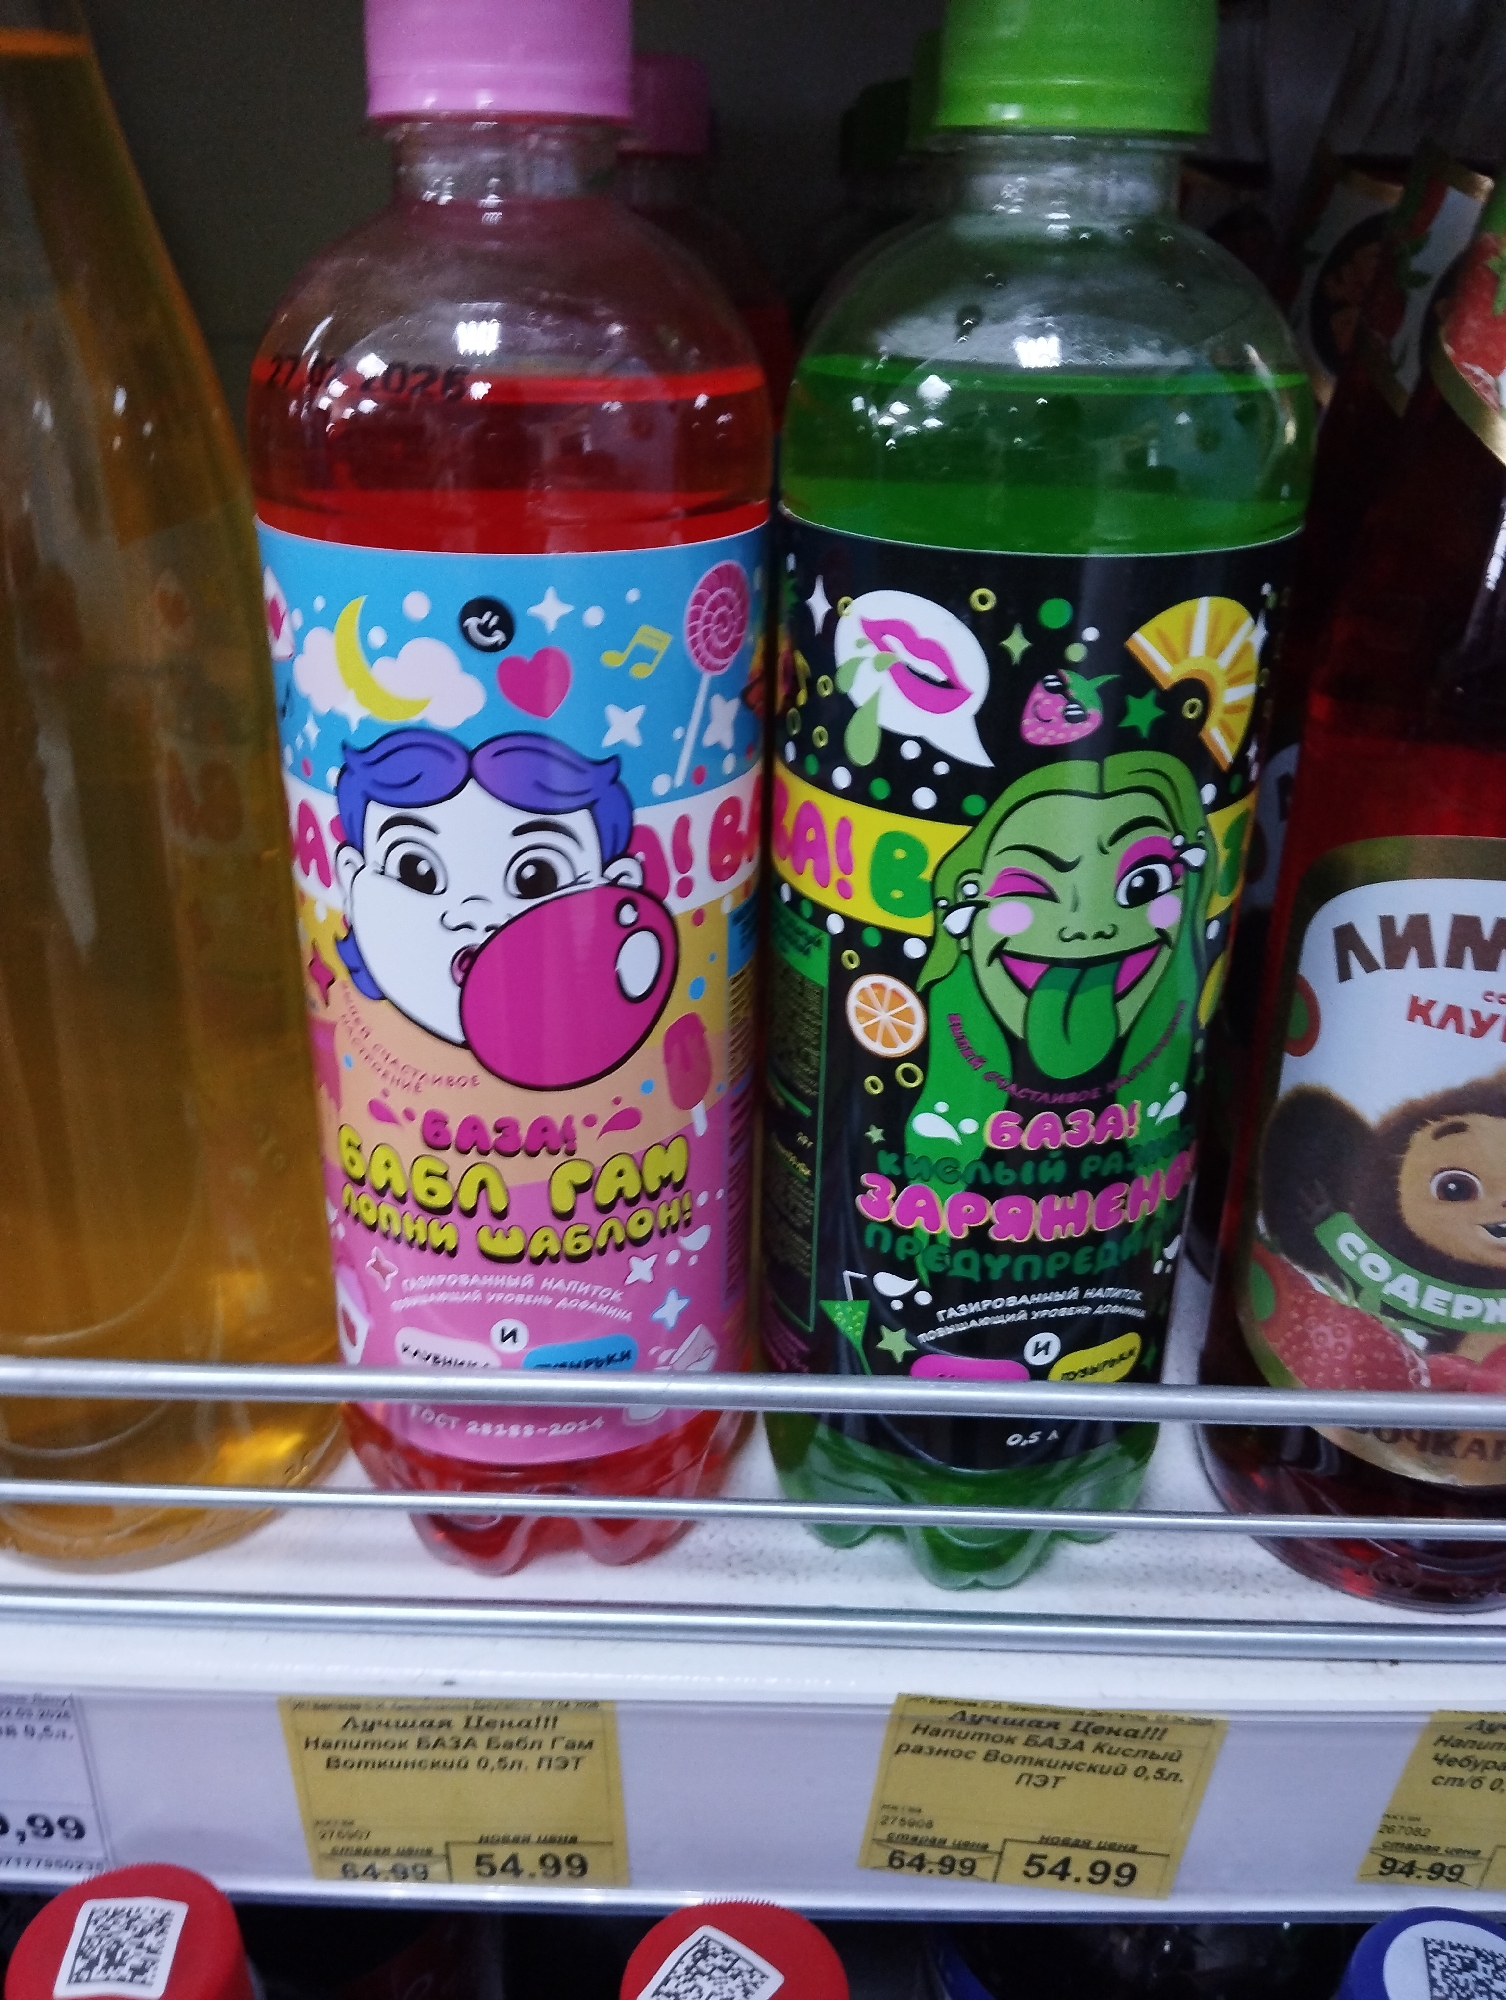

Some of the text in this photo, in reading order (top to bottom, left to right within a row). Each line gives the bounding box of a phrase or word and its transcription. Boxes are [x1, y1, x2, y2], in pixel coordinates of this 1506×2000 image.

[1407, 993, 1506, 1043] КЛУ
[421, 1109, 577, 1156] БАЗА!
[983, 1100, 1141, 1150] БАЗА!
[338, 1123, 510, 1216] БАБЛ
[549, 1134, 690, 1220] ГАМ
[878, 1150, 1067, 1186] КИСЛЫЙ
[342, 1183, 459, 1258] ЛОПНИ
[477, 1190, 694, 1263] ШАБЛОН!
[402, 1274, 624, 1303] ГАЗИРОВАННЫЙ НАПИТОК
[485, 1292, 553, 1307] УРОВЕНЬ
[554, 1297, 633, 1322] ДОФАМИНА
[936, 1286, 1144, 1322] ГАЗИРОВАННЫЙ НАПИТОК
[500, 1326, 519, 1344] И
[917, 1304, 1146, 1344] ПОВЫШАЮЩИЙ УРОВЕНЬ ДОФАМИНА
[1031, 1340, 1050, 1357] И
[410, 1404, 460, 1430] ГОСТ
[1006, 1431, 1042, 1446] 0,5
[341, 1715, 559, 1733] Лучшая Цена!!!
[948, 1710, 1060, 1731] Лучшая
[1070, 1720, 1168, 1741] Цена!!!
[304, 1736, 595, 1751] Напиток БАЗА Бабл Гам
[911, 1723, 1183, 1762] Напиток БАЗА Кислый
[326, 1756, 469, 1771] Воткинский
[537, 1756, 586, 1771] ПЭТ
[894, 1742, 1184, 1783] разнос Воткинский 0,5л.
[1015, 1772, 1066, 1788] ПЭТ
[887, 1832, 990, 1852] старая цена
[1040, 1834, 1139, 1853] новая цена
[1381, 1841, 1481, 1857] старая цена
[341, 1862, 429, 1881] 64.99
[475, 1852, 589, 1879] 54.99
[887, 1849, 978, 1877] 64.99
[1022, 1852, 1138, 1888] 54.99
[1378, 1857, 1465, 1882] 94.99
